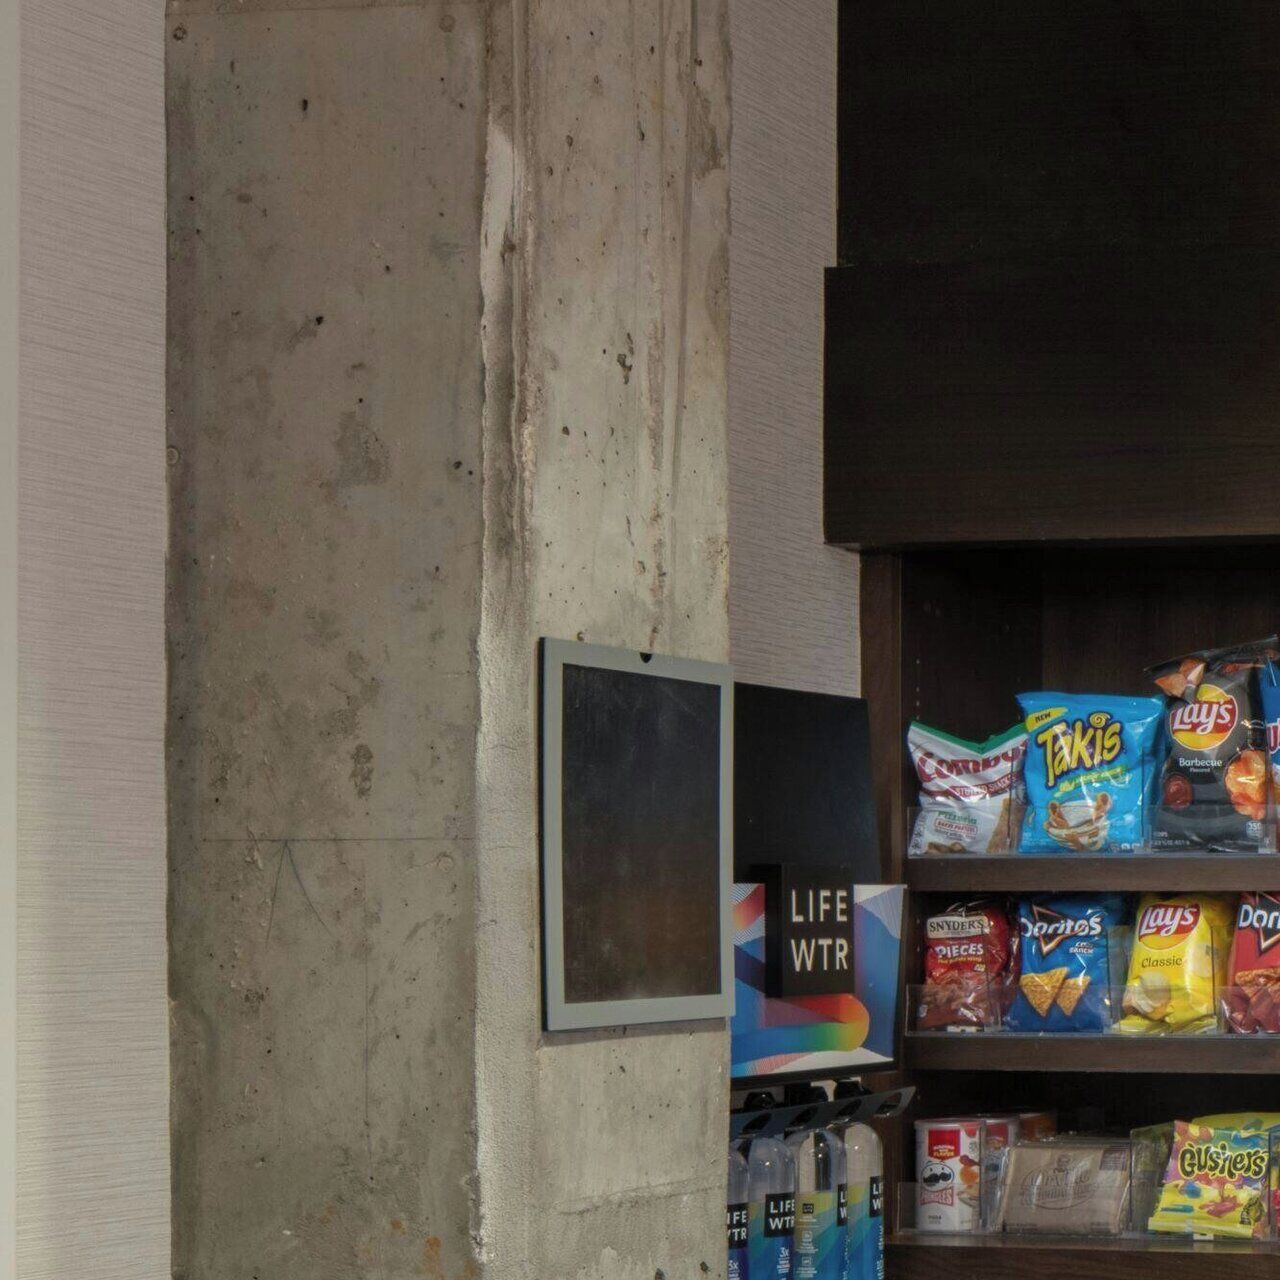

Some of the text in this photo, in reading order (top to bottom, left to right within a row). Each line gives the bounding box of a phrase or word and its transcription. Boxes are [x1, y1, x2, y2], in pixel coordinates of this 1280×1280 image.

[1171, 698, 1232, 734] Lay's
[1036, 712, 1122, 787] Takis
[1178, 757, 1223, 768] Barbecue
[791, 888, 848, 923] LIFE
[1140, 903, 1199, 937] Lay's
[790, 938, 849, 972] WTR
[935, 944, 984, 958] PIECES
[1140, 956, 1183, 969] Classic
[728, 1209, 748, 1225] IFE
